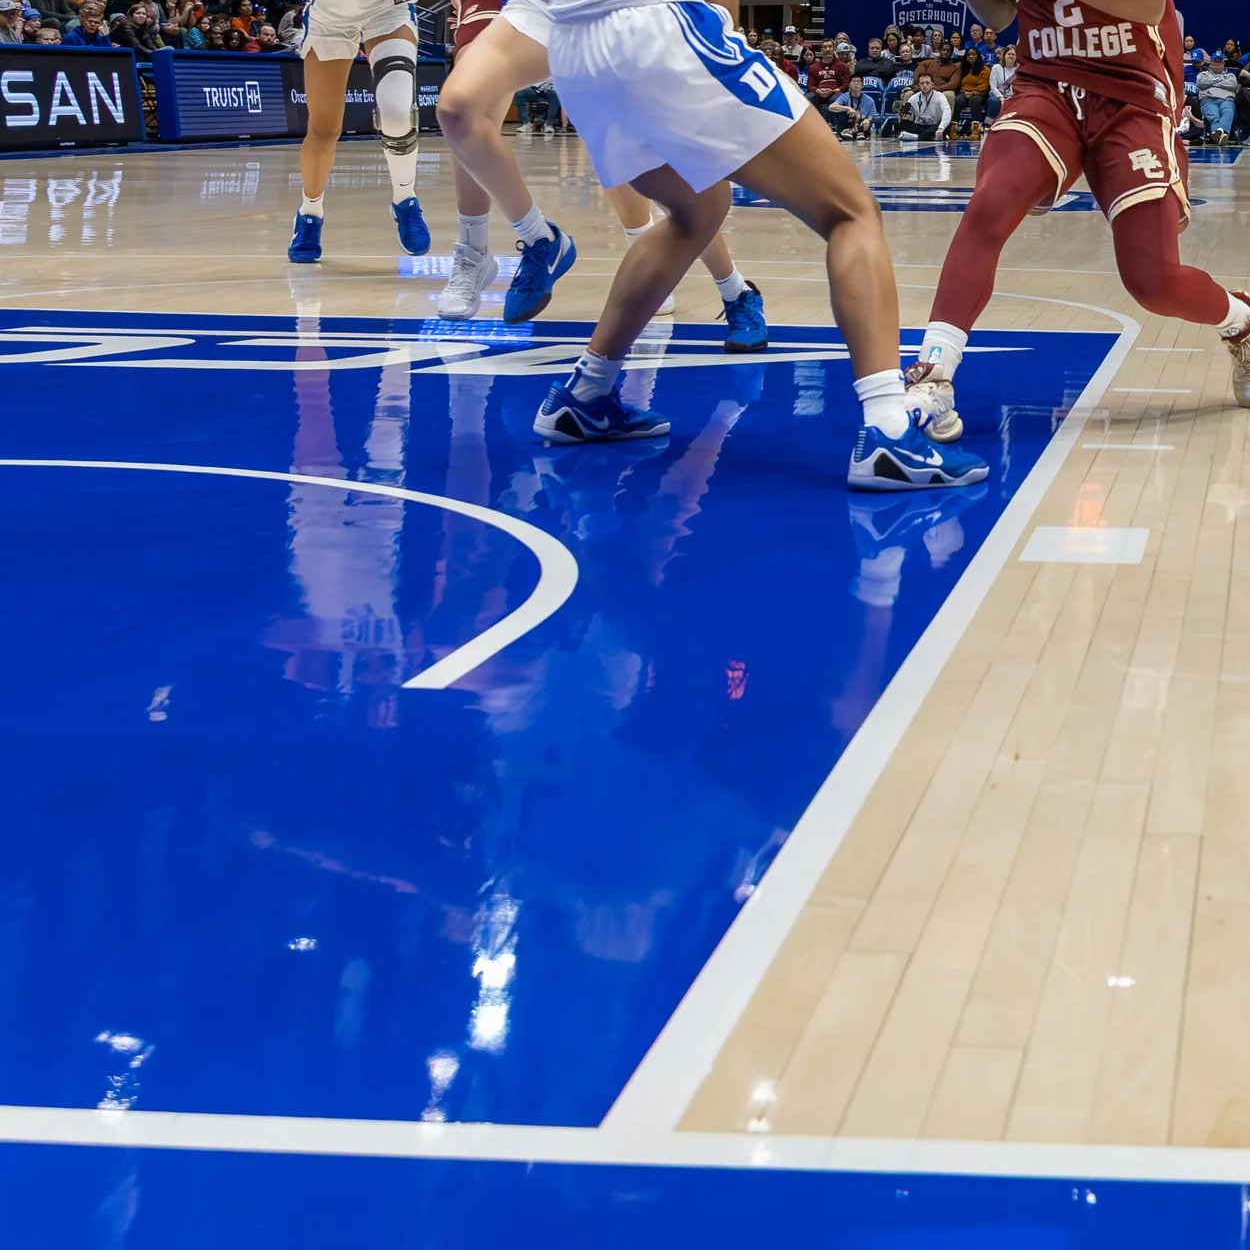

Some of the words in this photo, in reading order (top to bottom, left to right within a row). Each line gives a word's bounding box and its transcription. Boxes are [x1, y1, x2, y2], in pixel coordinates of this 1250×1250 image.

[898, 8, 961, 27] SISTERHOOD
[1027, 21, 1138, 60] COLLEGE
[203, 86, 245, 108] TRUIST
